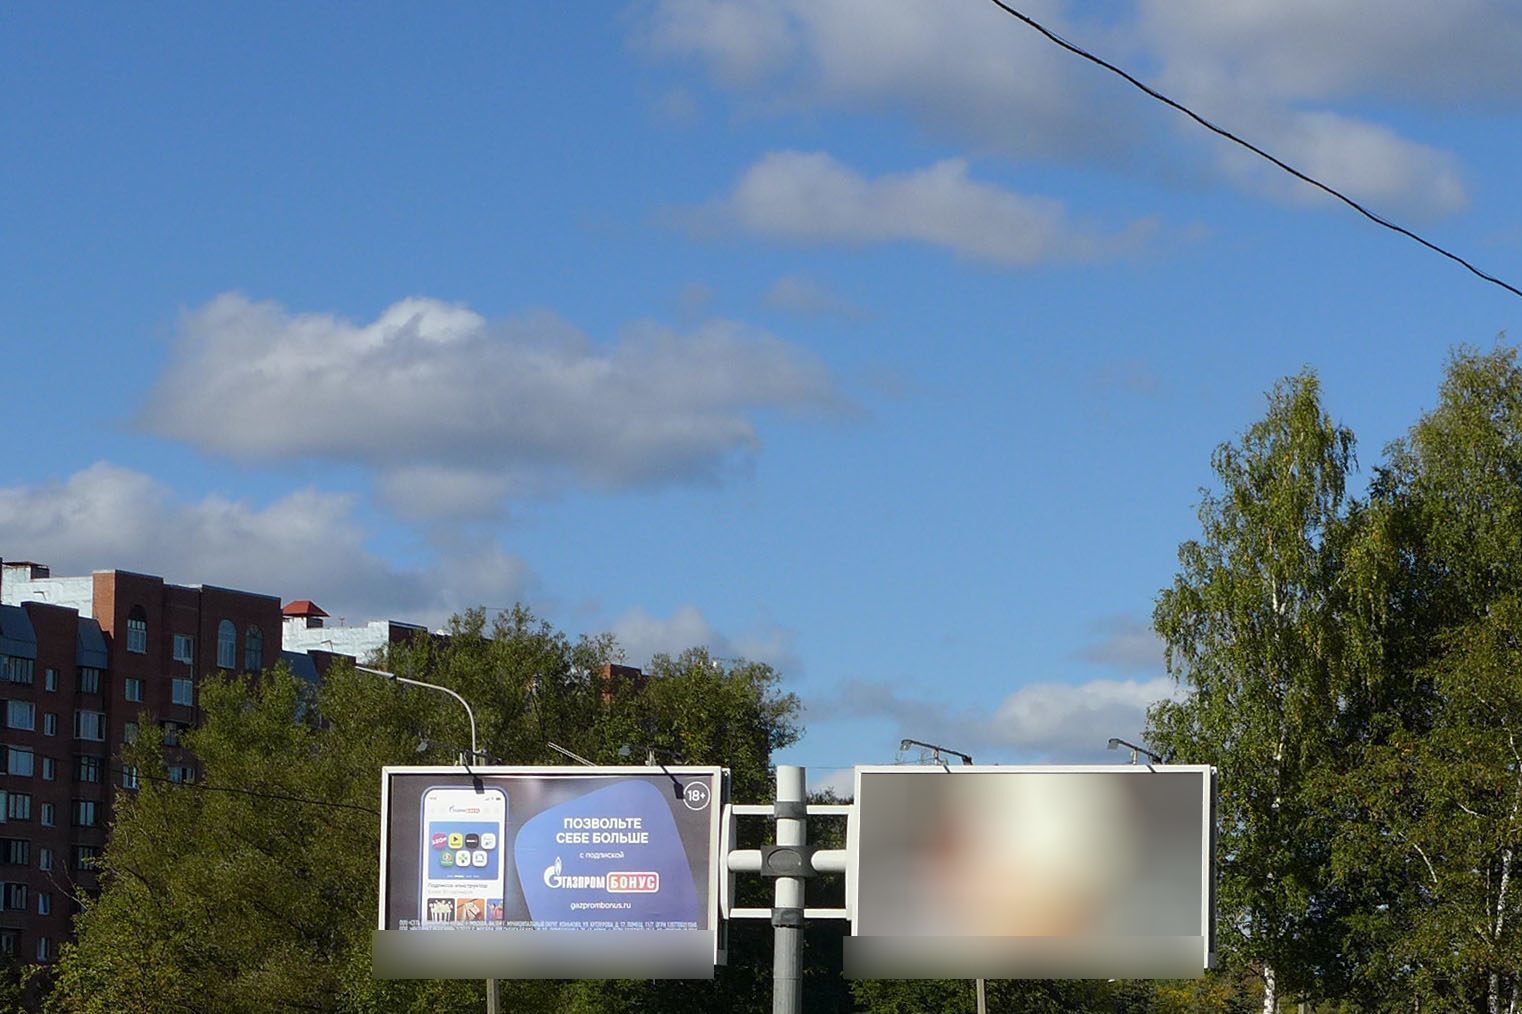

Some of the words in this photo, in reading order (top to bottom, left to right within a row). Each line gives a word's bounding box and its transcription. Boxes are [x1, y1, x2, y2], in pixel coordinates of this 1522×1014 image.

[687, 789, 706, 801] 18+
[563, 817, 642, 830] ПОЗВОЛЬТЕ
[556, 832, 590, 844] СЕБЕ
[592, 832, 649, 844] БОЛЬШЕ
[585, 850, 625, 860] подпиской
[561, 876, 606, 889] ГАЗПРОМ
[610, 875, 656, 889] БОНУС
[570, 902, 632, 911] gazprombonus.ru
